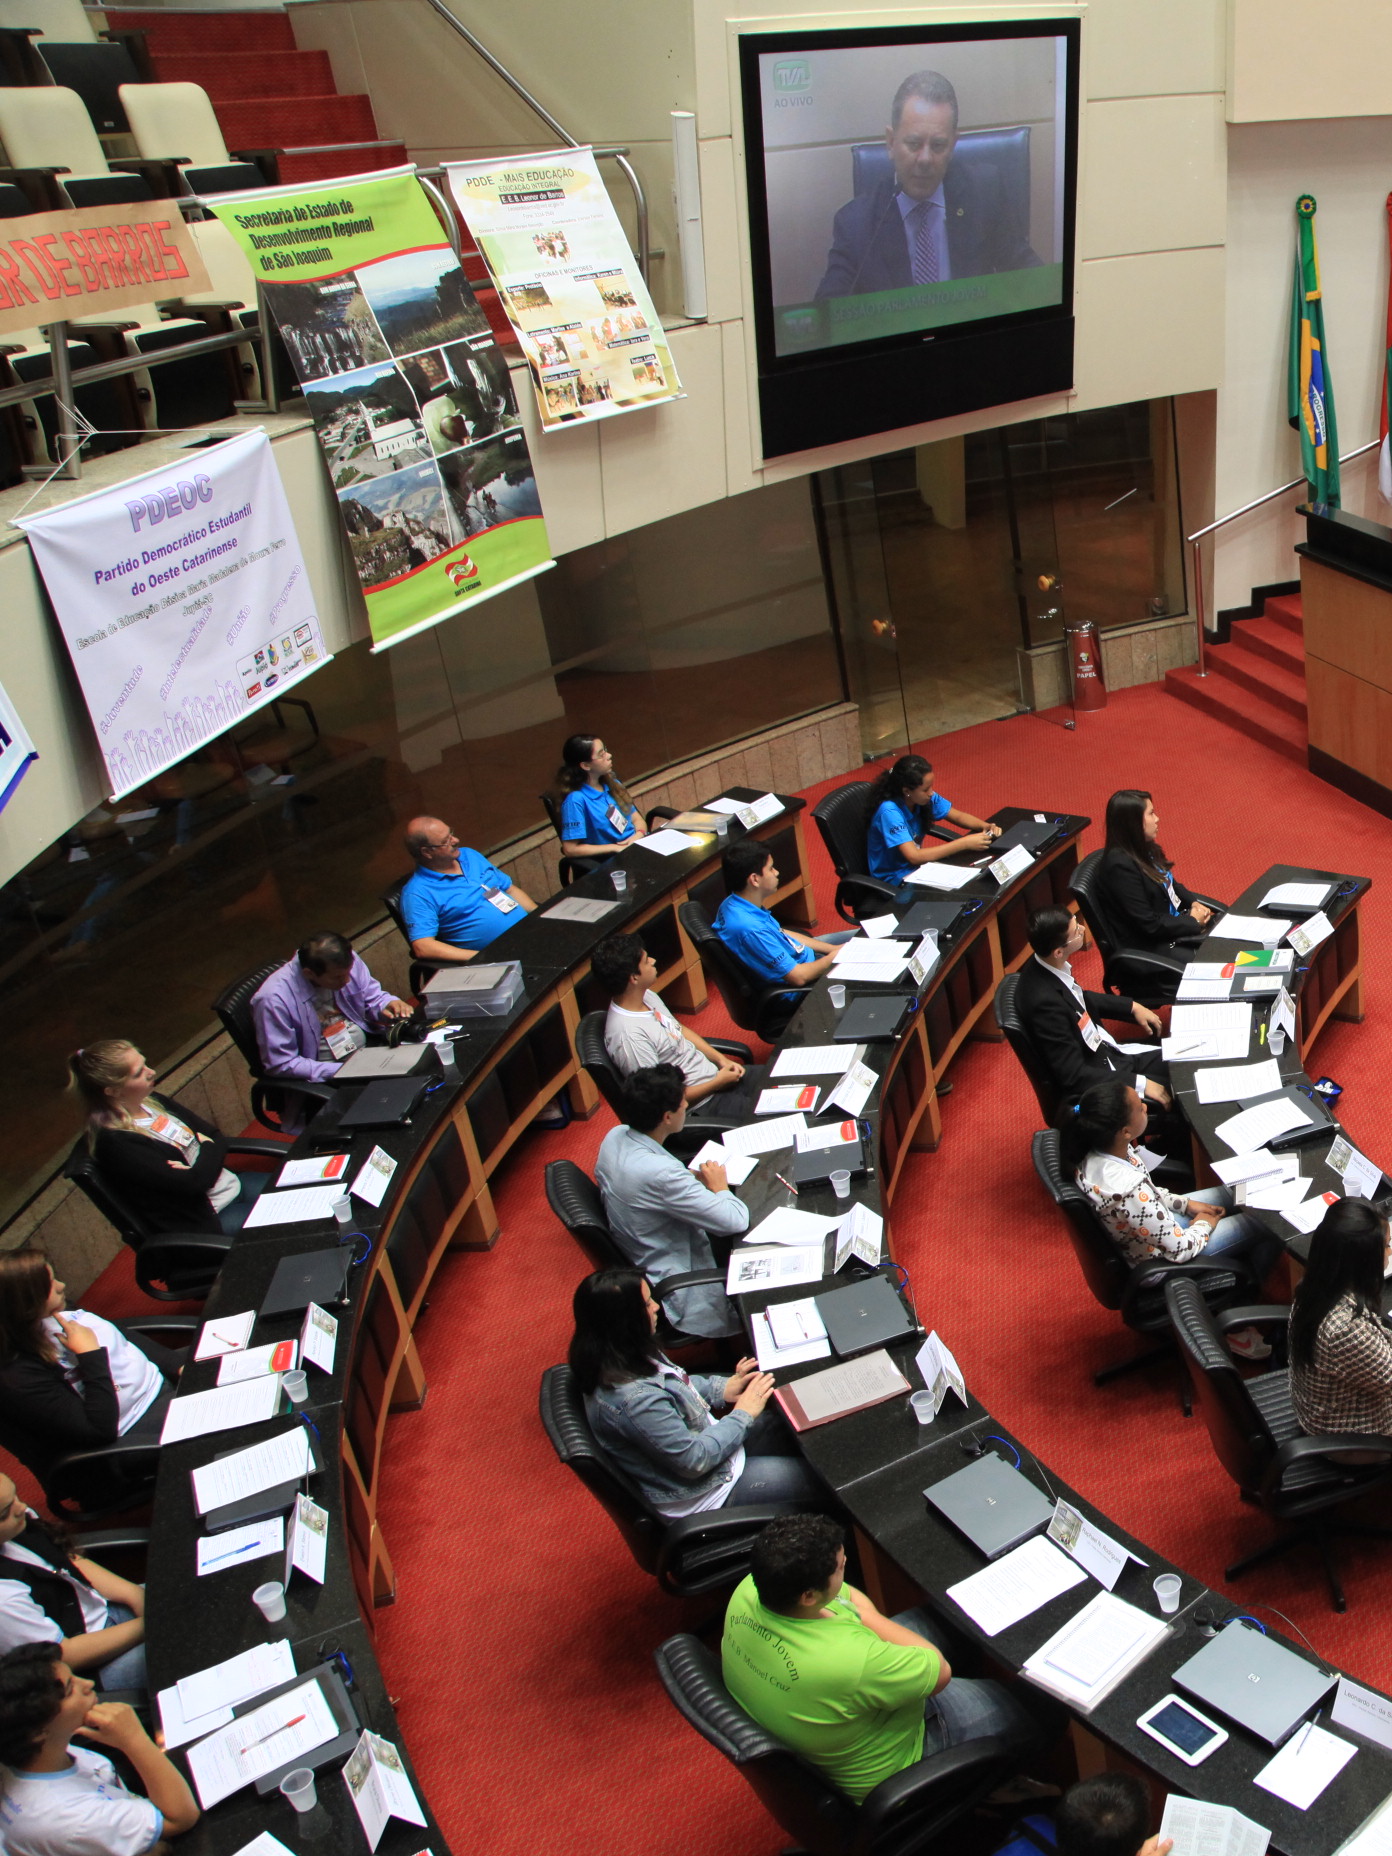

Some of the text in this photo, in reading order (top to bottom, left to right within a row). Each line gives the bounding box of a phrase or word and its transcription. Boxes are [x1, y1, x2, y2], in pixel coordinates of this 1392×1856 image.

[775, 96, 814, 108] AO VIVO
[466, 176, 494, 188] PDDE
[504, 172, 524, 184] MAIS
[526, 167, 574, 182] EDUCAÇÃO
[498, 181, 560, 192] EDUCAÇÃO INTEGRAL
[521, 192, 539, 202] Leonor
[540, 192, 547, 200] de
[547, 190, 565, 200] Barros
[234, 199, 354, 230] Secretaria de Estado de
[248, 216, 375, 250] Desenvolvimento Regional
[61, 220, 190, 293] BARROS
[260, 246, 334, 272] de São Joaquim
[535, 270, 558, 279] OFICINAS
[564, 265, 593, 275] MONITORES
[832, 285, 988, 322] SESSÃO PARLAMENTO JOVEM
[124, 474, 213, 532] PDEOC
[94, 503, 252, 585] Partido Democrático Estudantil
[131, 537, 238, 596] do Oeste Catarinense
[76, 630, 106, 650] Escola
[108, 623, 118, 635] de
[116, 604, 160, 628] Educação
[161, 590, 187, 610] Básica
[187, 580, 208, 598] Maria
[239, 558, 248, 570] de
[248, 547, 271, 563] Moura
[269, 564, 302, 625] #Progresso
[226, 604, 251, 647] #União
[160, 606, 213, 702] #Intelectualidade
[101, 664, 144, 735] #Juventude
[1102, 1545, 1121, 1564] Rodrigues
[730, 1612, 800, 1682] Parlamento Jovem
[744, 1654, 768, 1680] Manoel
[770, 1676, 791, 1692] Cruz
[1344, 1690, 1370, 1707] Leonardo
